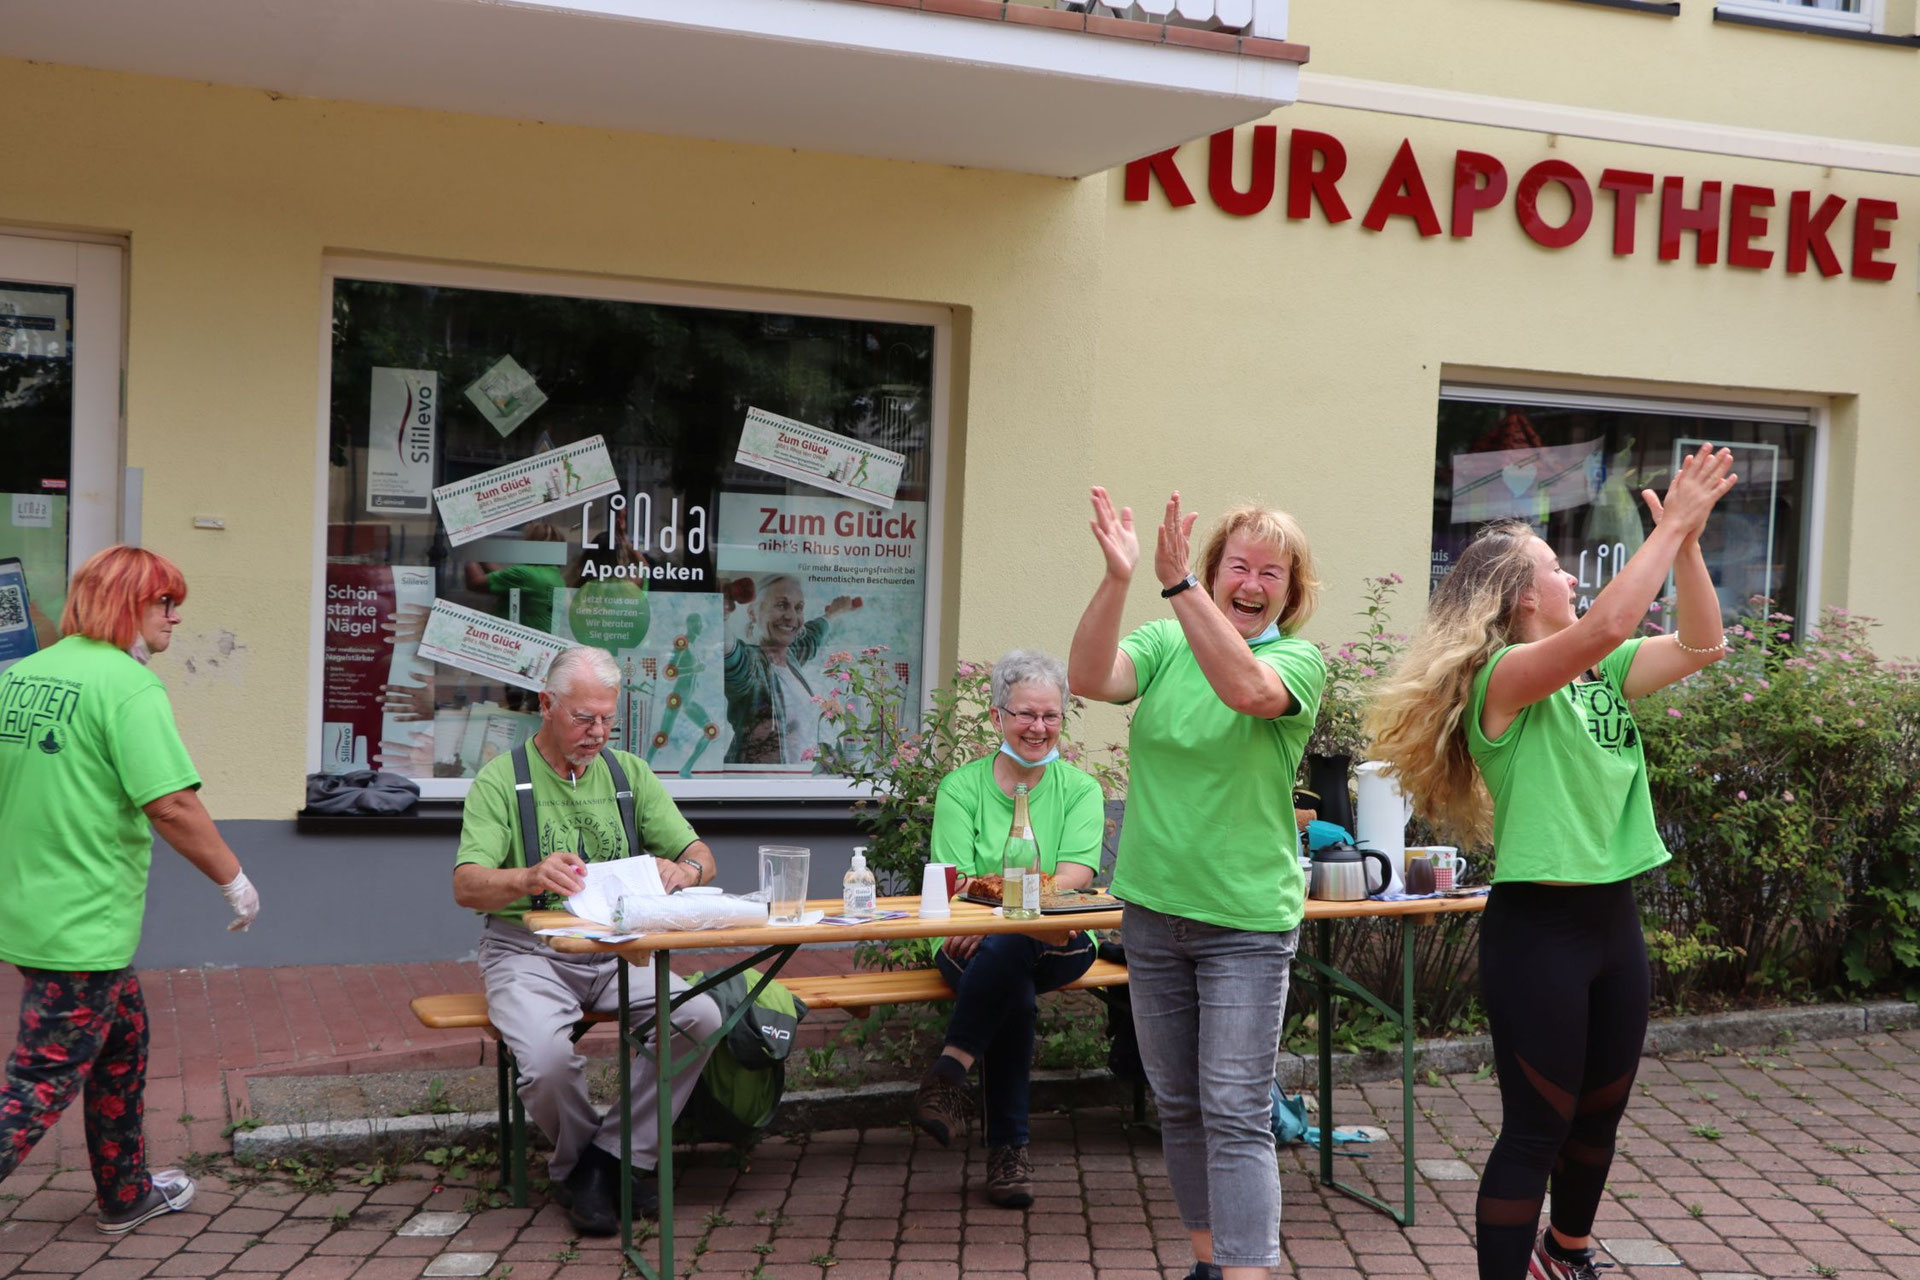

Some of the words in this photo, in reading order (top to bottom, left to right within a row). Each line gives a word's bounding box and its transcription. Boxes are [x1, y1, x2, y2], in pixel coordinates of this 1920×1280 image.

[1124, 124, 1899, 281] KURAPOTHEKE
[411, 385, 433, 465] Sililevo
[778, 432, 800, 448] Zum
[801, 439, 830, 456] Glück
[475, 487, 500, 503] Zum
[500, 476, 532, 493] Glück
[759, 507, 826, 536] Zum
[834, 510, 917, 539] Glück
[758, 540, 798, 557] gibt's
[802, 541, 840, 556] Rhus
[843, 546, 871, 557] von
[874, 544, 912, 559] DHU!
[581, 559, 704, 582] Apotheken
[834, 565, 903, 575] Bewegungsfreiheit
[904, 566, 916, 575] bei
[1578, 542, 1626, 588] Lin
[808, 574, 865, 585] rheumatischen
[867, 576, 916, 586] Beschwerden
[327, 584, 377, 601] Schön
[582, 595, 602, 605] Jetzt
[604, 598, 623, 606] raus
[624, 598, 640, 606] aus
[327, 602, 377, 617] starke
[576, 606, 592, 616] den
[593, 606, 638, 617] Schmerzen
[326, 617, 377, 636] Nägel
[585, 618, 600, 628] Wir
[601, 618, 634, 629] beraten
[465, 625, 490, 641] Zum
[490, 633, 522, 651] Glück
[588, 630, 602, 640] Sie
[603, 631, 630, 642] gerne!
[340, 728, 352, 763] Sililevo
